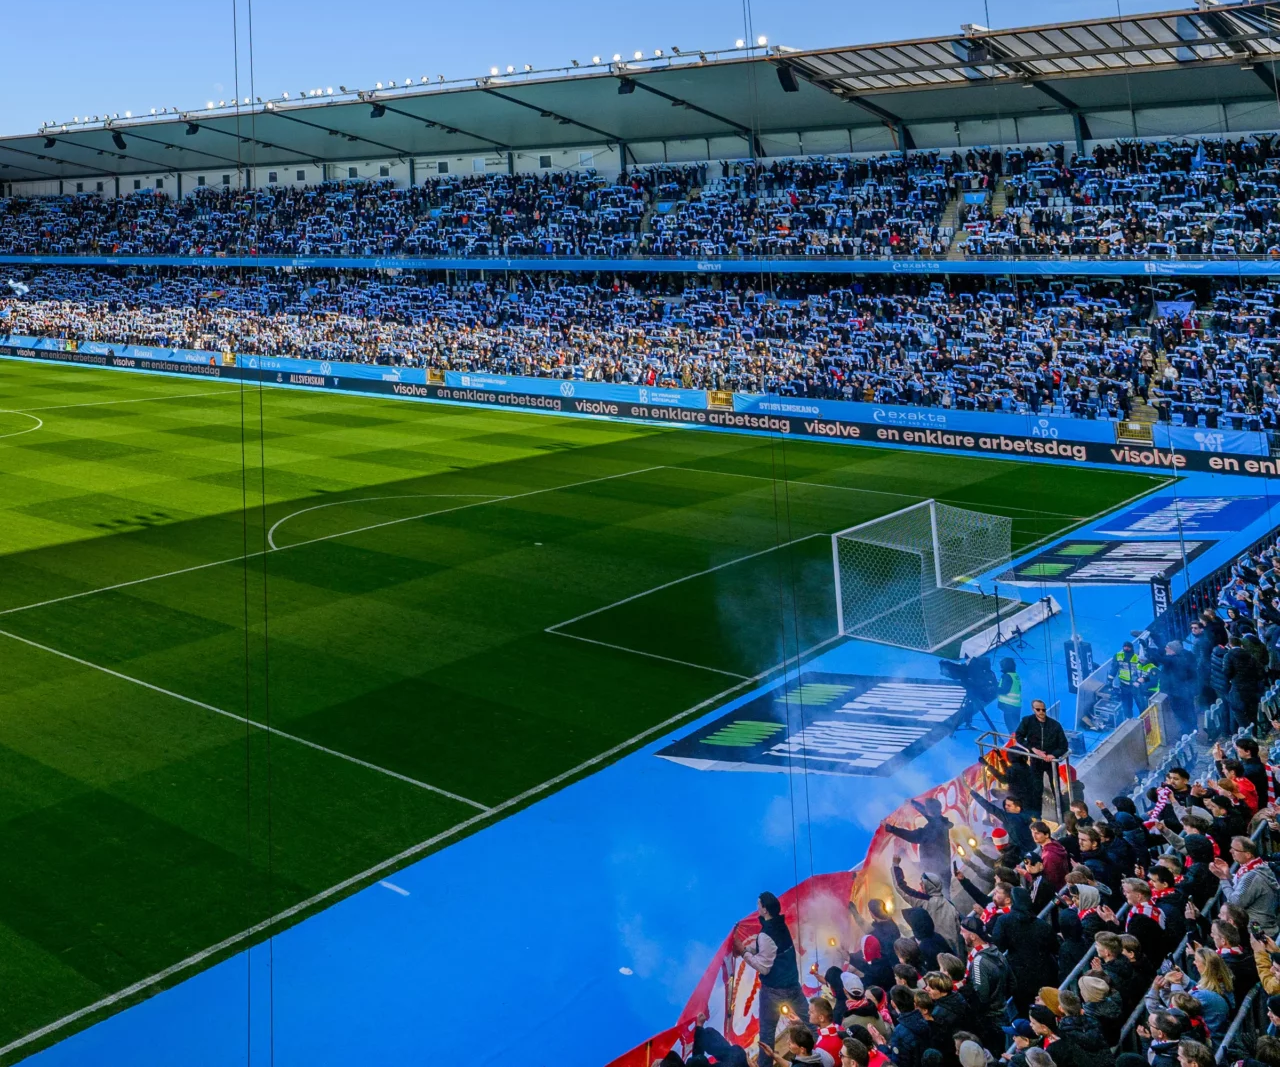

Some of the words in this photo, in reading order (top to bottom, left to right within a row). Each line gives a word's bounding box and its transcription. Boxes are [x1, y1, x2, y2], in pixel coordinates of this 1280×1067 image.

[17, 347, 36, 358] visolve
[49, 351, 72, 361] enklare
[73, 353, 107, 366] arbetsdag
[112, 356, 136, 368] visolve
[141, 361, 151, 369] en
[151, 361, 179, 372] enklare
[180, 363, 221, 377] arbetsdag
[289, 374, 325, 387] ALLSVENSKAN
[393, 383, 428, 397] visolve
[437, 388, 451, 399] en
[453, 388, 496, 403] enklare
[498, 393, 562, 411] arbetsdag
[575, 399, 618, 415] visolve
[758, 402, 812, 414] SYDSVENSKAN
[631, 406, 648, 419] en
[651, 407, 706, 423] enklare
[708, 410, 791, 434] arbetsdag
[888, 411, 946, 423] exakta
[804, 420, 860, 438] visolve
[876, 427, 900, 441] en
[903, 429, 975, 448] enklare
[978, 432, 1088, 462] arbetsdag
[1111, 445, 1187, 468] visolve
[1208, 456, 1240, 472] en
